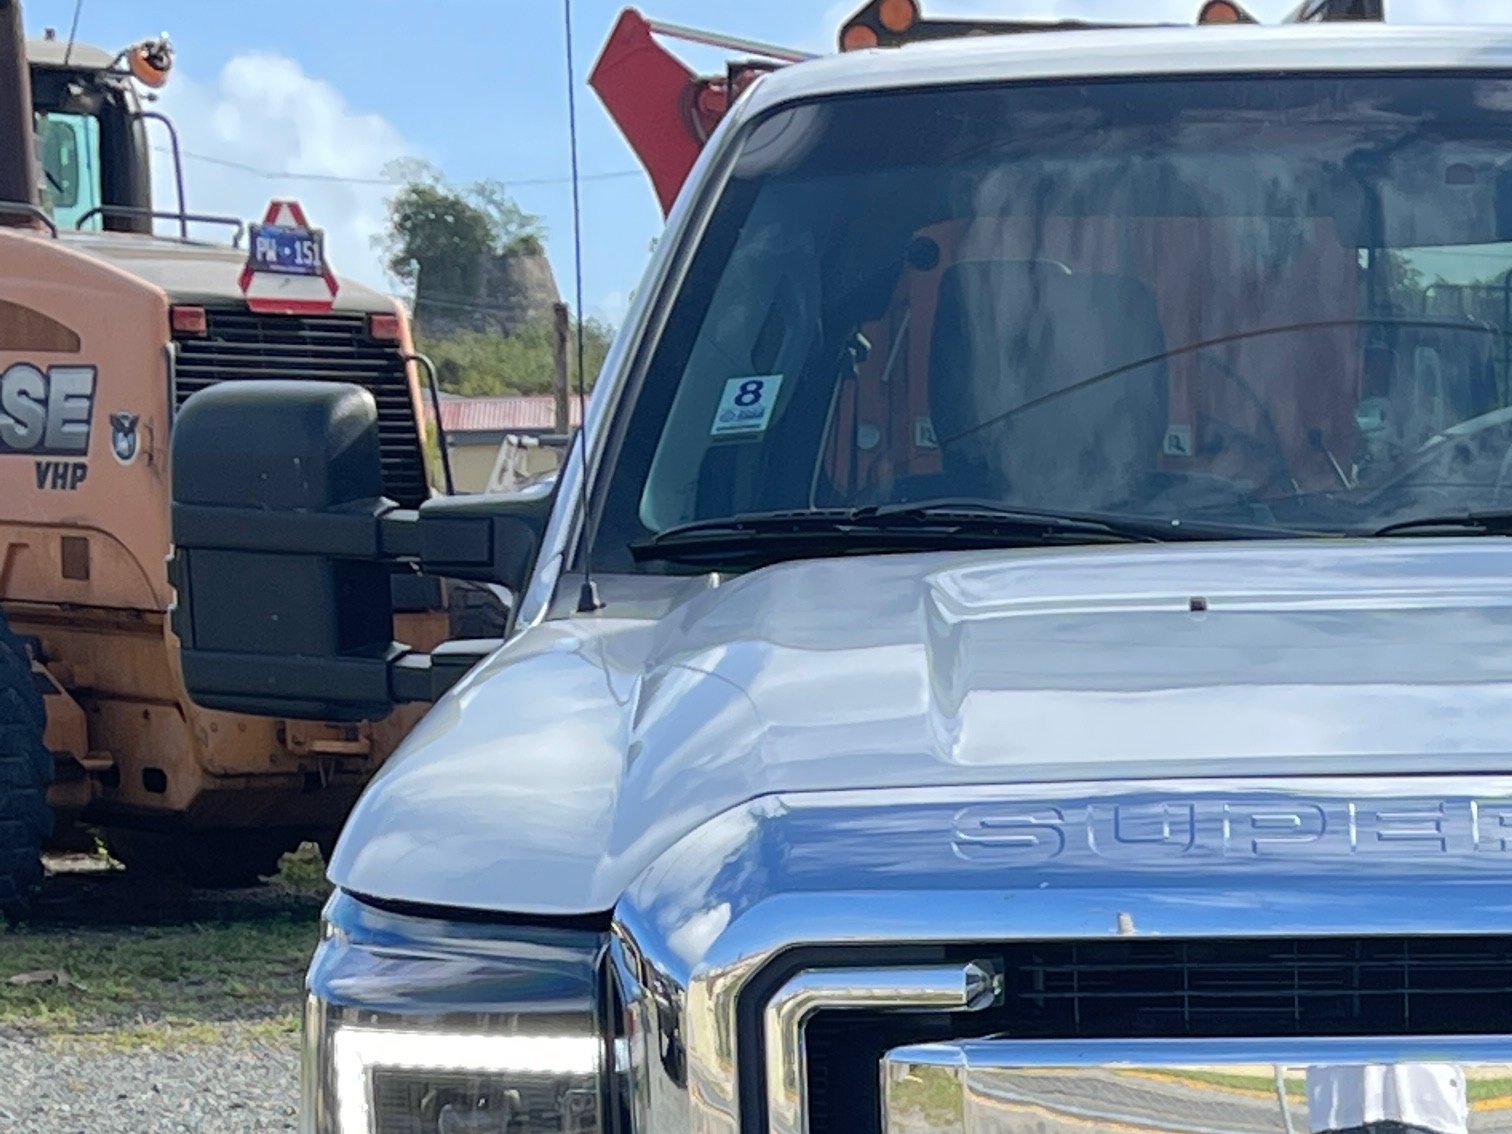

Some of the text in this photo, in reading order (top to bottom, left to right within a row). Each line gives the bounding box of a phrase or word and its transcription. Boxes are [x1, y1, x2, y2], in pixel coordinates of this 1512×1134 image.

[294, 240, 321, 266] 151
[734, 379, 764, 407] 8
[35, 460, 88, 490] VHP
